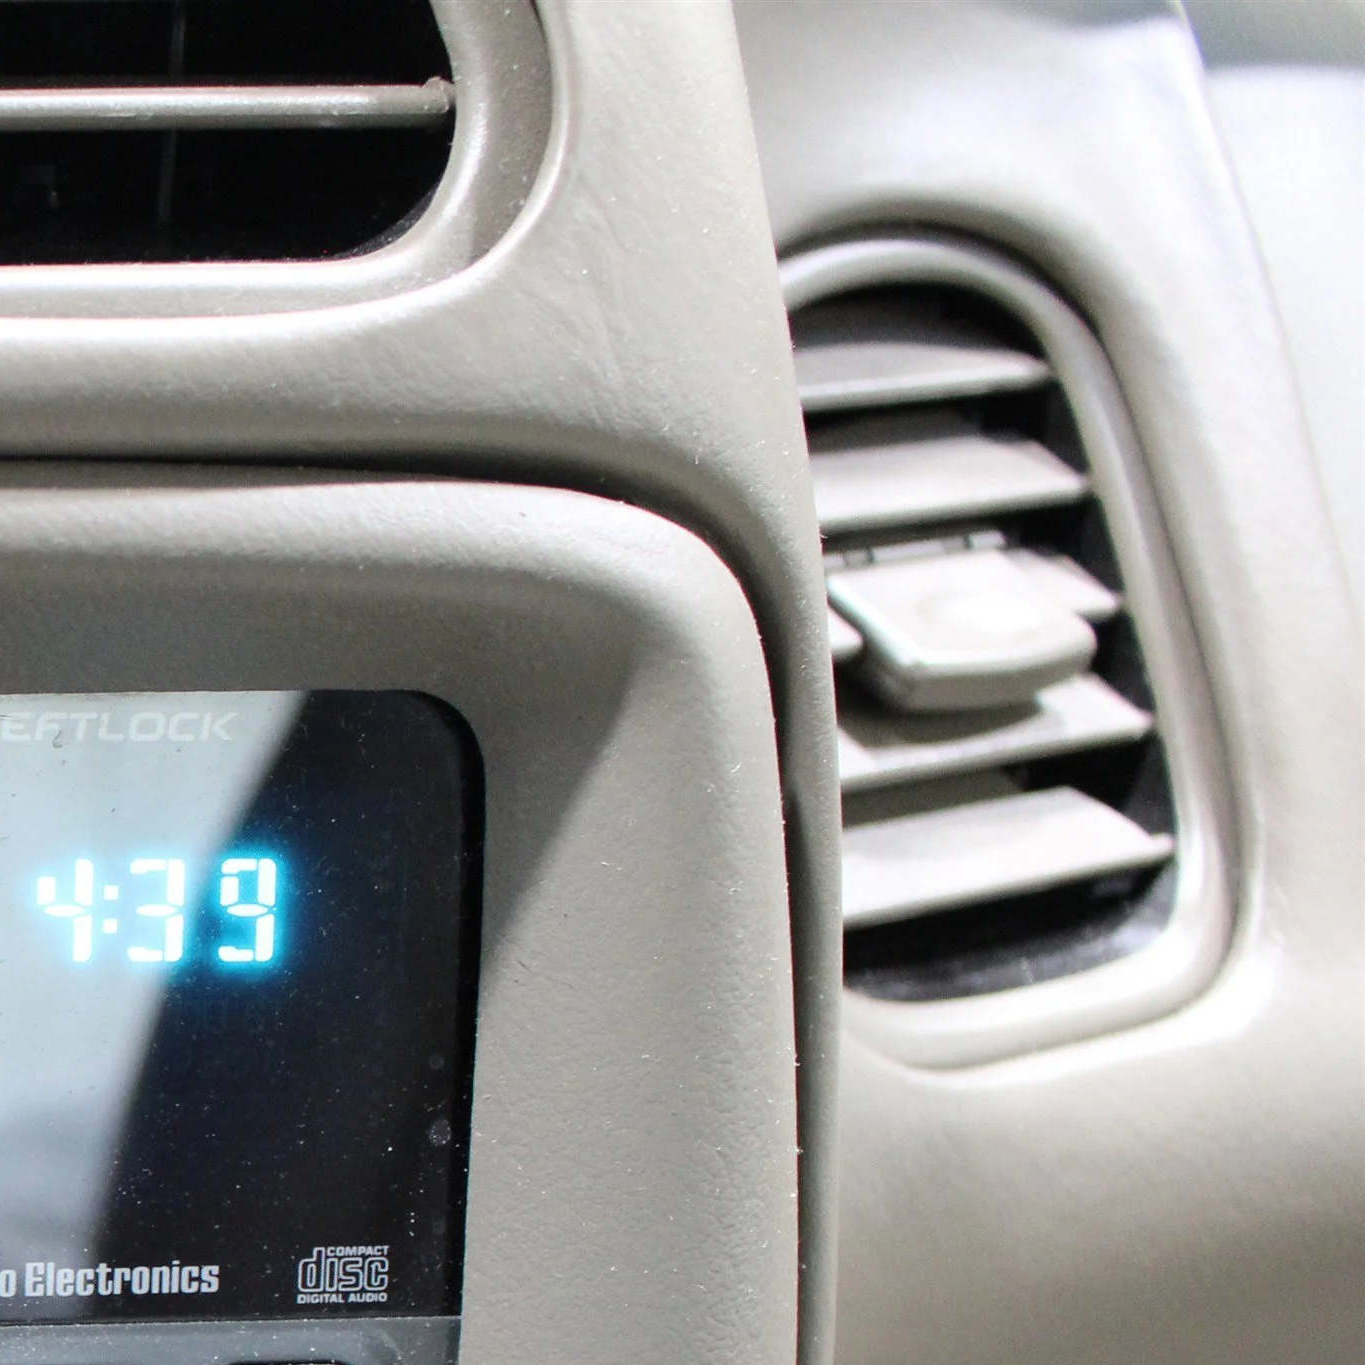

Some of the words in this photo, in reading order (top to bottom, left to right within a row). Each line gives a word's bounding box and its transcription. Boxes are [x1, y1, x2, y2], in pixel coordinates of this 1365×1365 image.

[35, 857, 278, 963] 4:39
[325, 1245, 389, 1257] COMPACT
[23, 1259, 220, 1298] Electronics
[296, 1292, 345, 1304] DIGITAL
[347, 1292, 388, 1303] AUDIO
